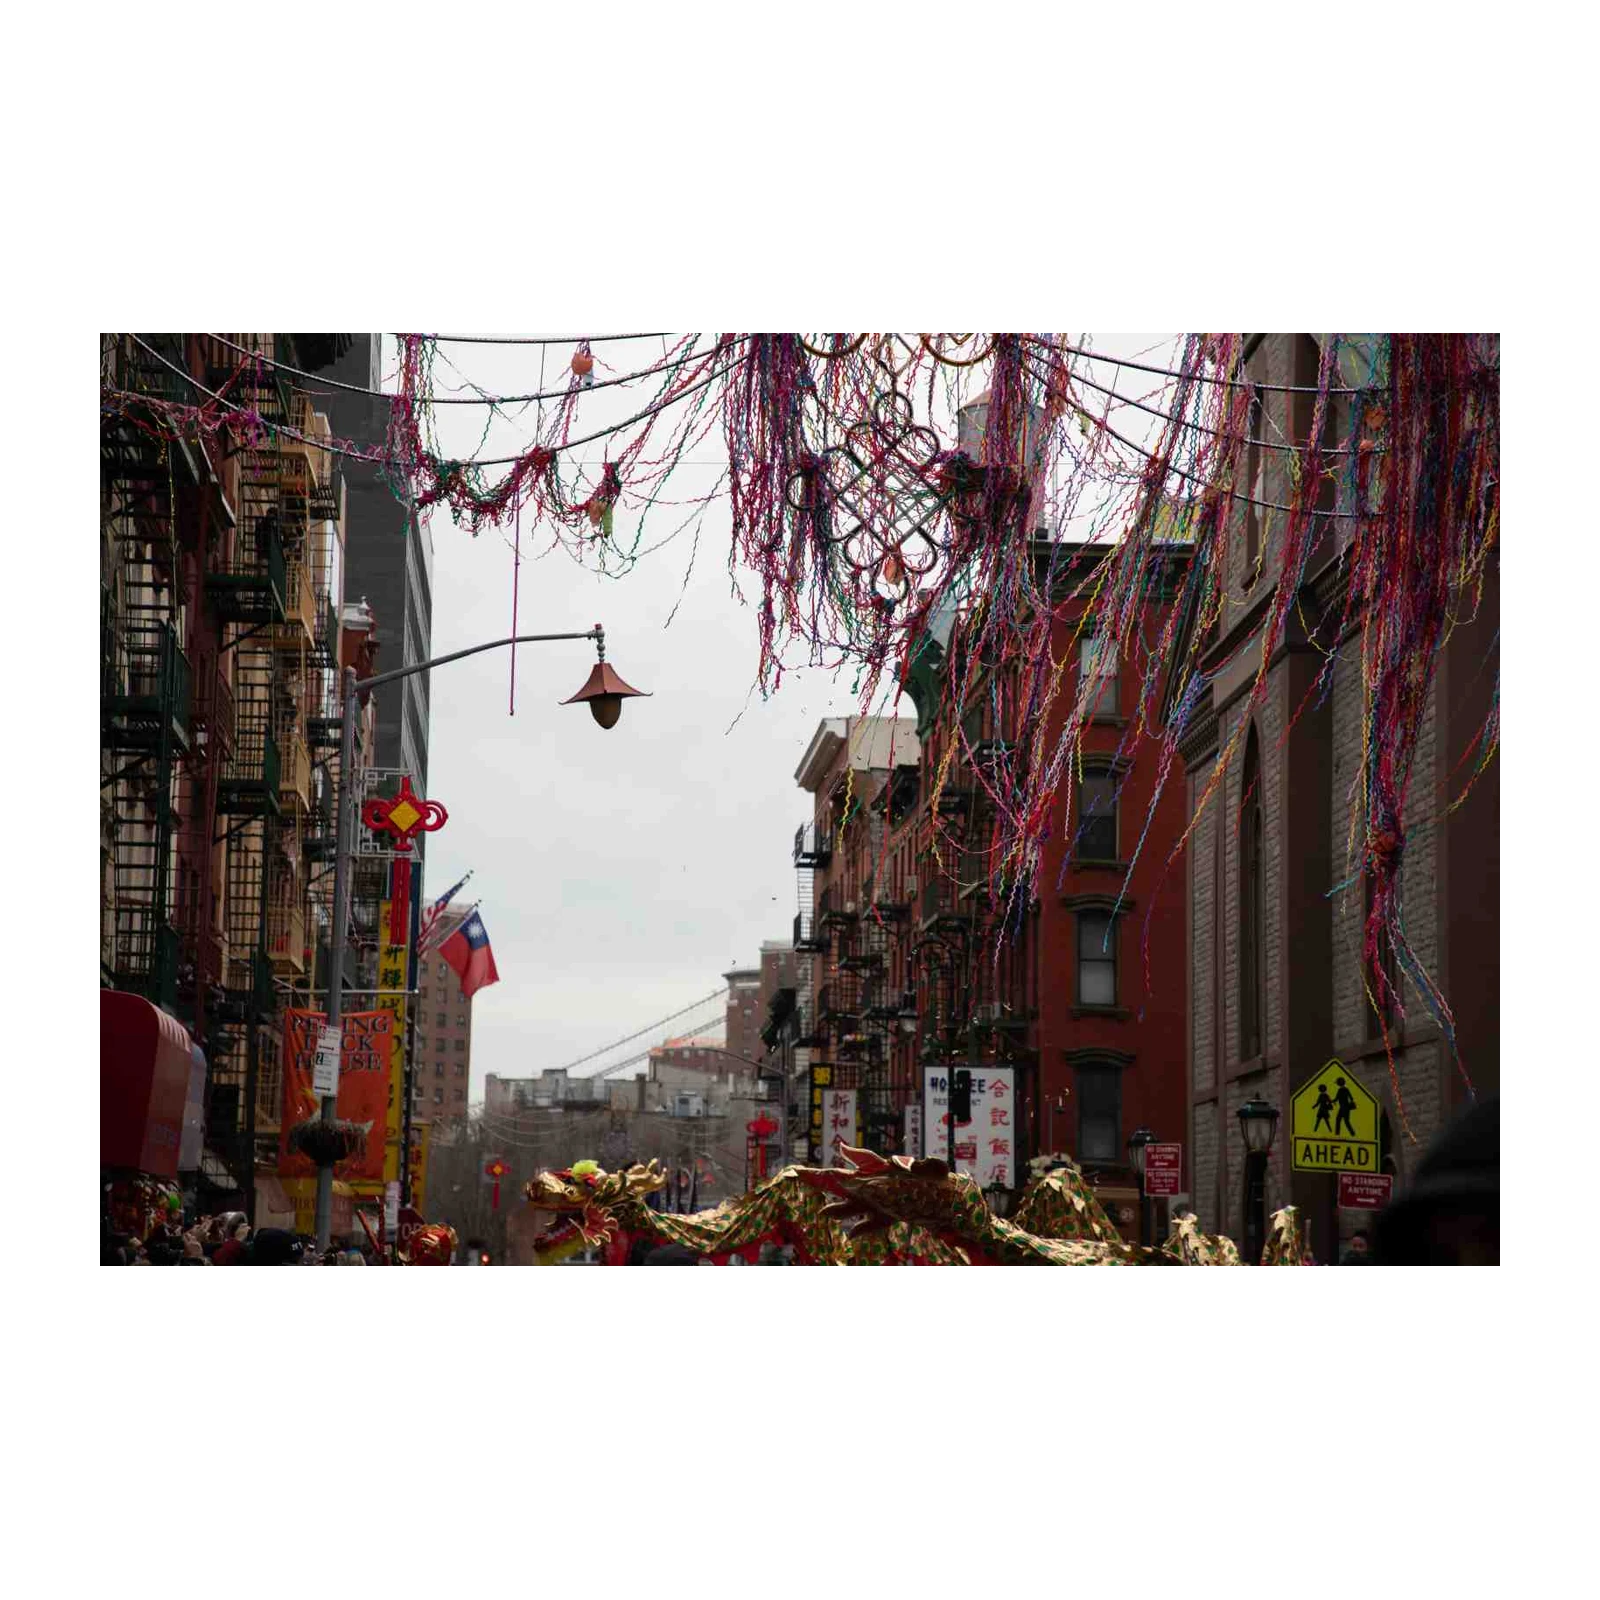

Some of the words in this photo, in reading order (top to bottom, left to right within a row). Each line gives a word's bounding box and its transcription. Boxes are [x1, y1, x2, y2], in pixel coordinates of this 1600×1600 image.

[292, 1016, 388, 1034] PEING
[1302, 1144, 1369, 1165] AHEAD
[1342, 1176, 1352, 1184] NO
[1354, 1177, 1389, 1187] STANDING
[1347, 1186, 1384, 1196] ANYTIME
